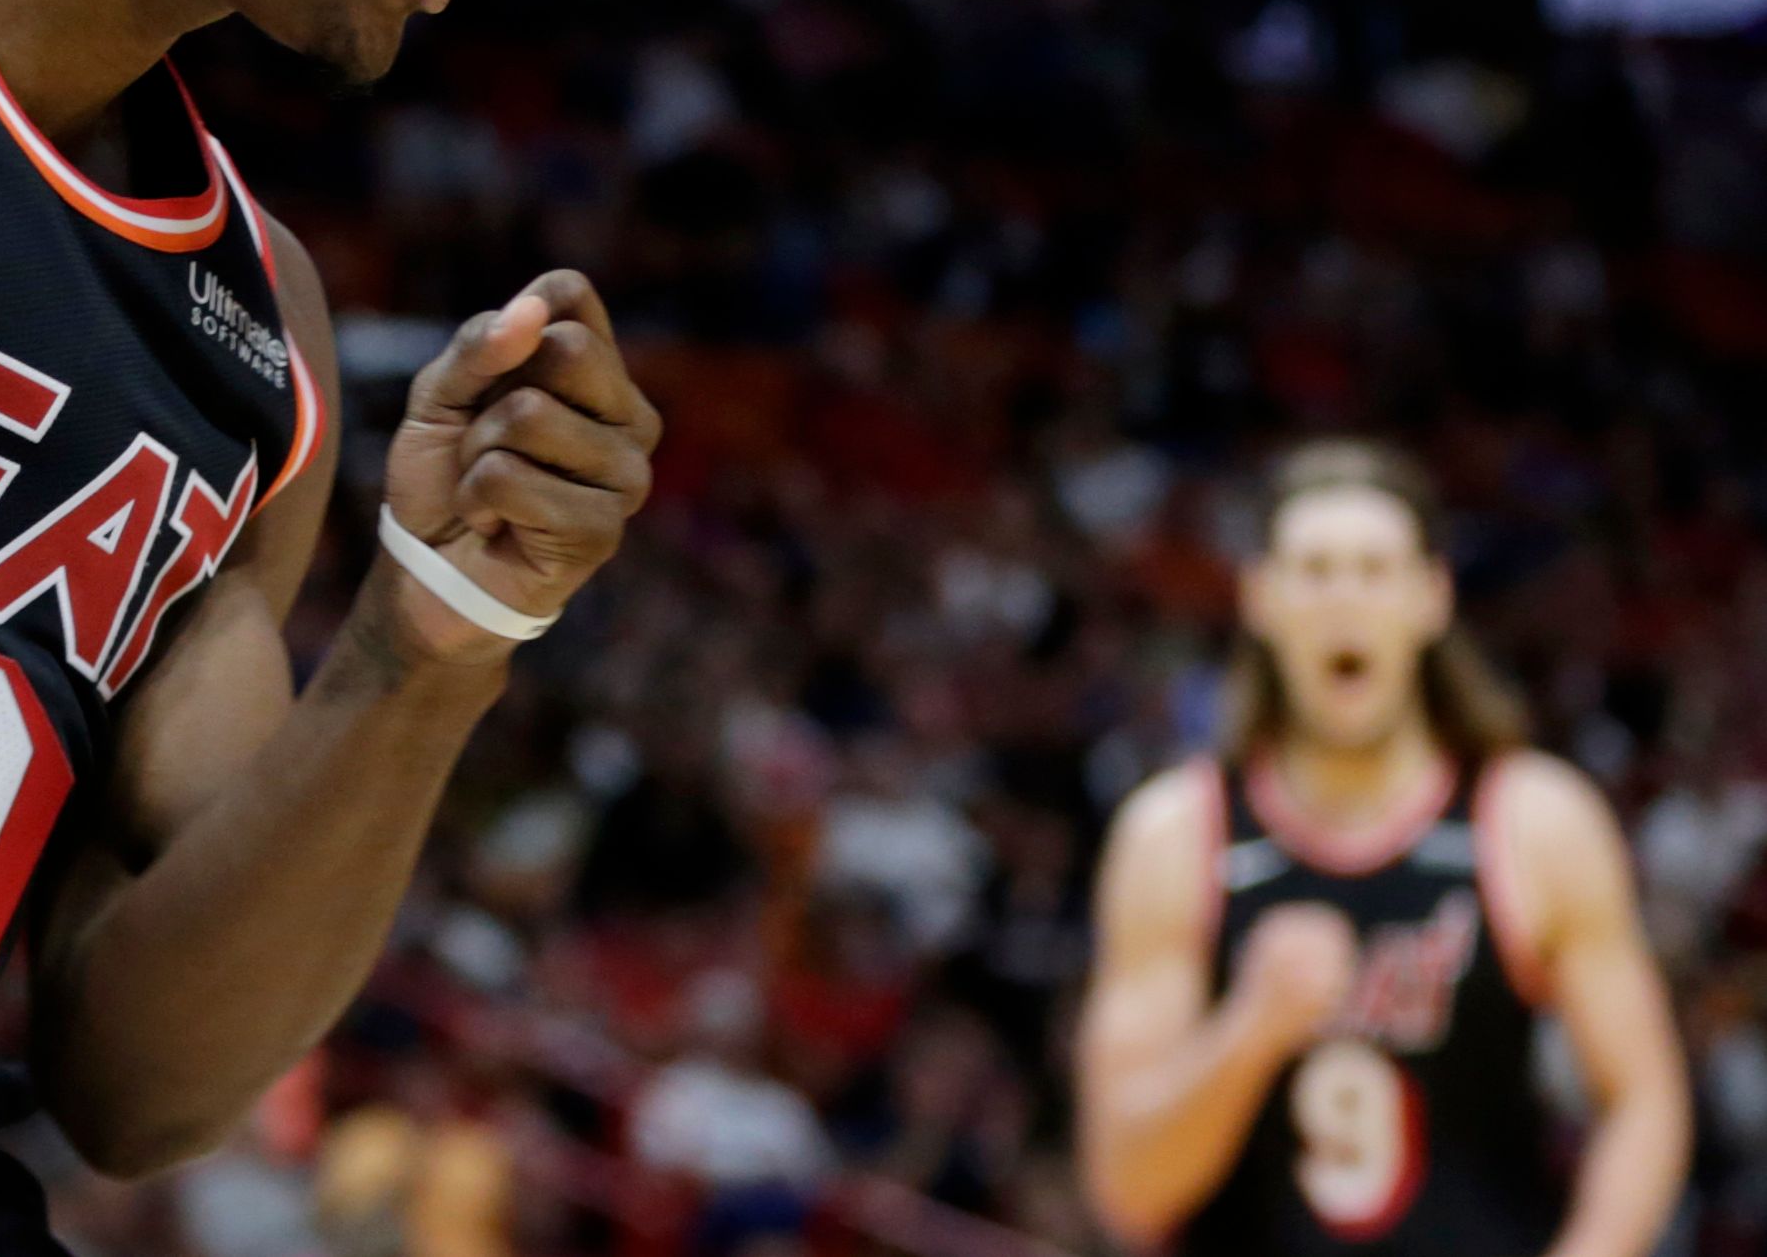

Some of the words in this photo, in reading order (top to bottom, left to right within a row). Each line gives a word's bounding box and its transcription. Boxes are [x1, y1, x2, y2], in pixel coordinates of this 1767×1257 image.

[188, 260, 288, 368] Ultimate
[190, 306, 286, 389] SOFTWARE
[1290, 1040, 1429, 1242] 9
